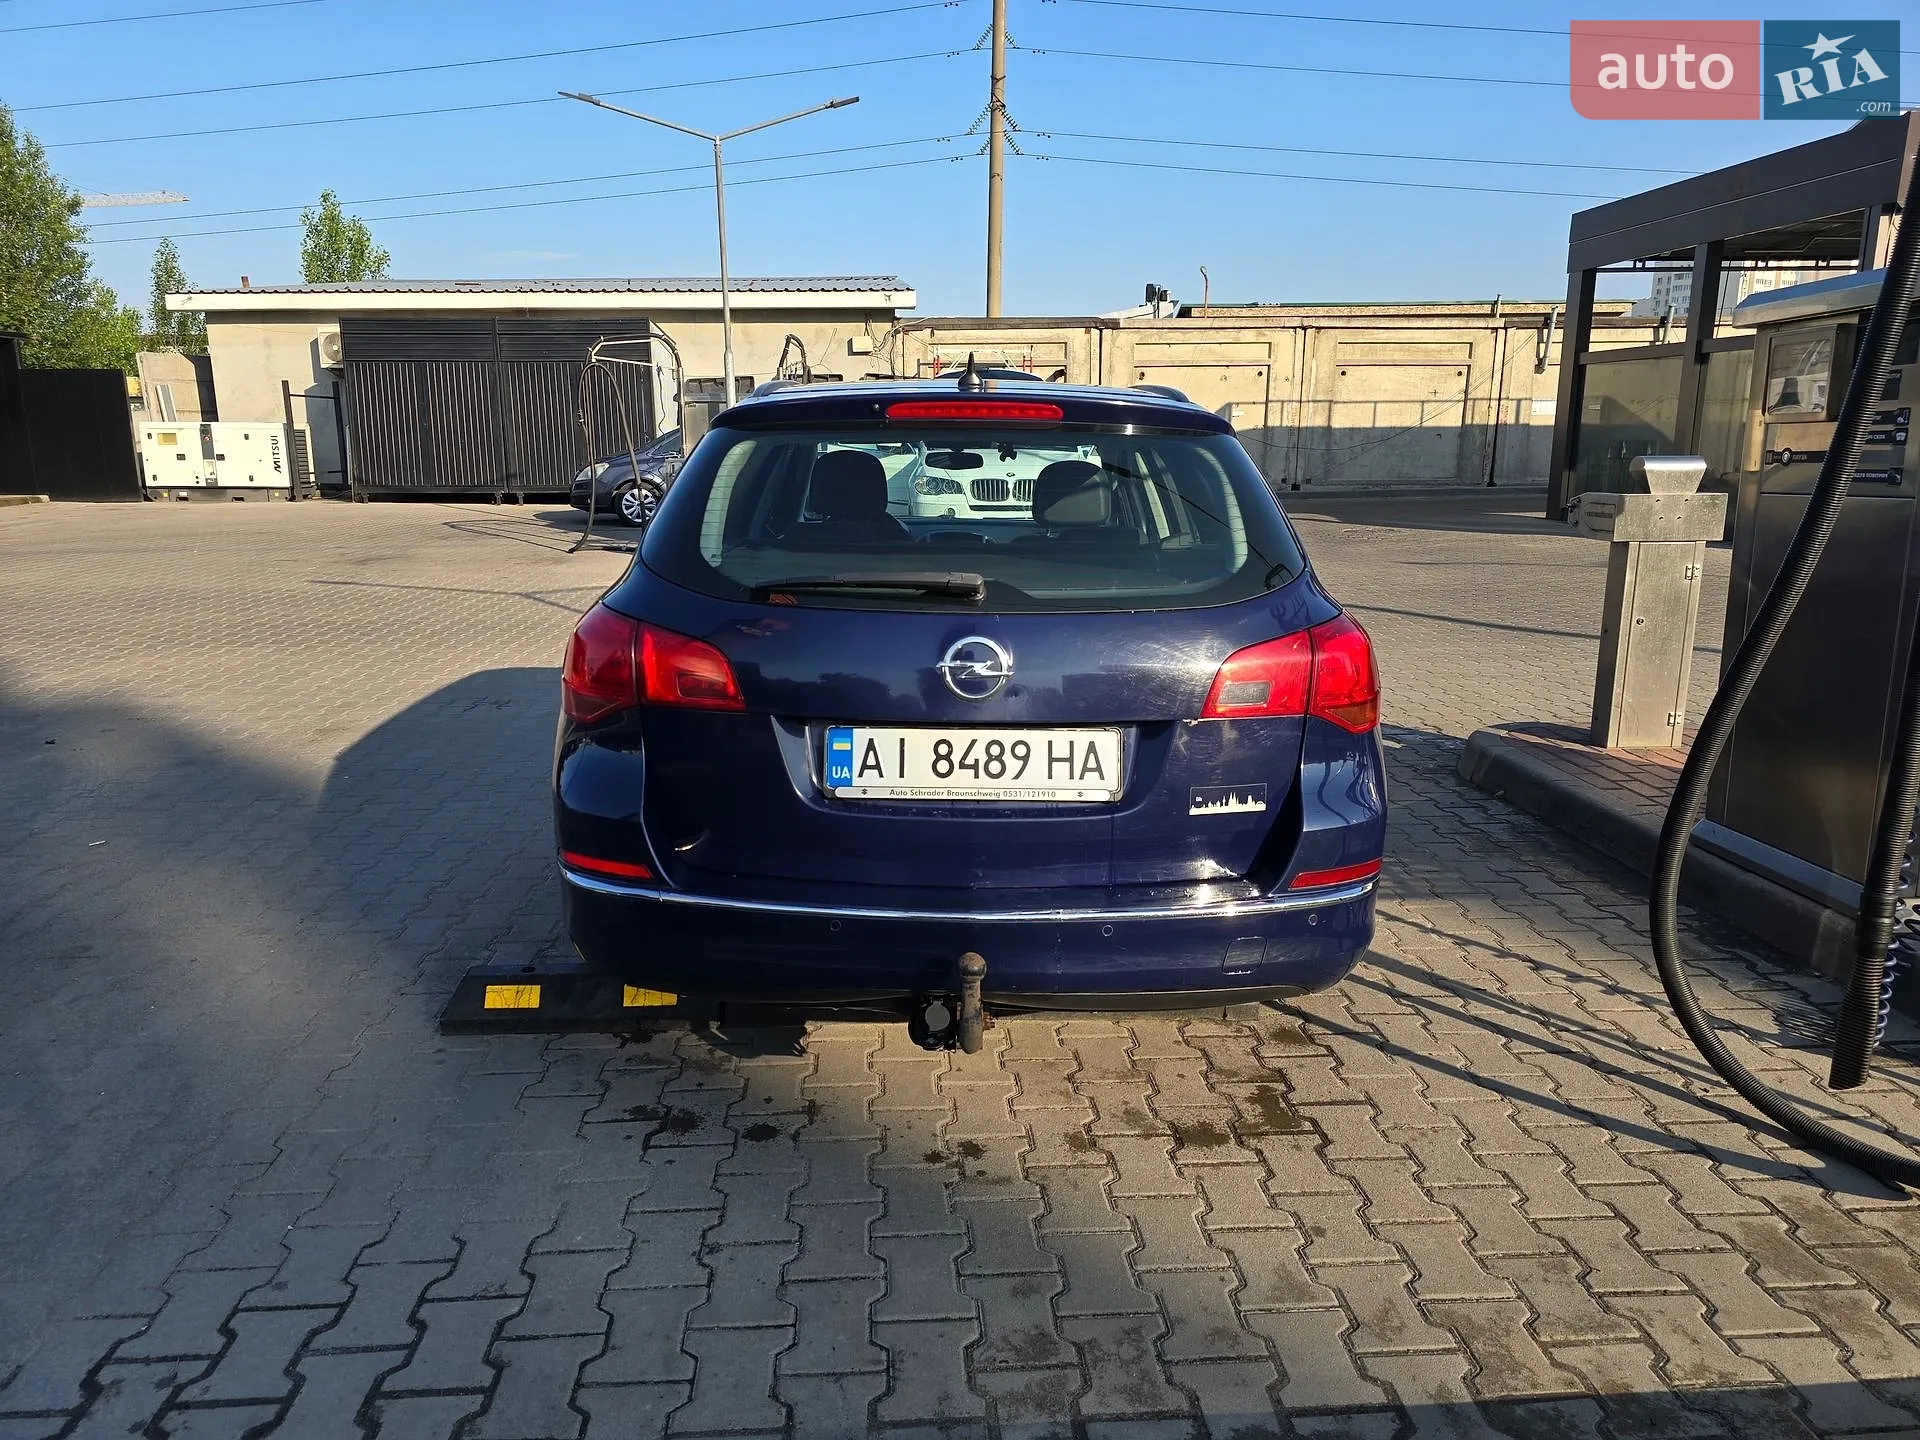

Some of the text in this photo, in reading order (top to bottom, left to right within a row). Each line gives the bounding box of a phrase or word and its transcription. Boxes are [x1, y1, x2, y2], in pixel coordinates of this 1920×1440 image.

[270, 435, 282, 474] MITSUI
[857, 737, 1106, 781] AI 8489 HA
[832, 766, 851, 779] UA
[947, 790, 1001, 798] Braunschweig
[1003, 790, 1056, 798] 0531/121910
